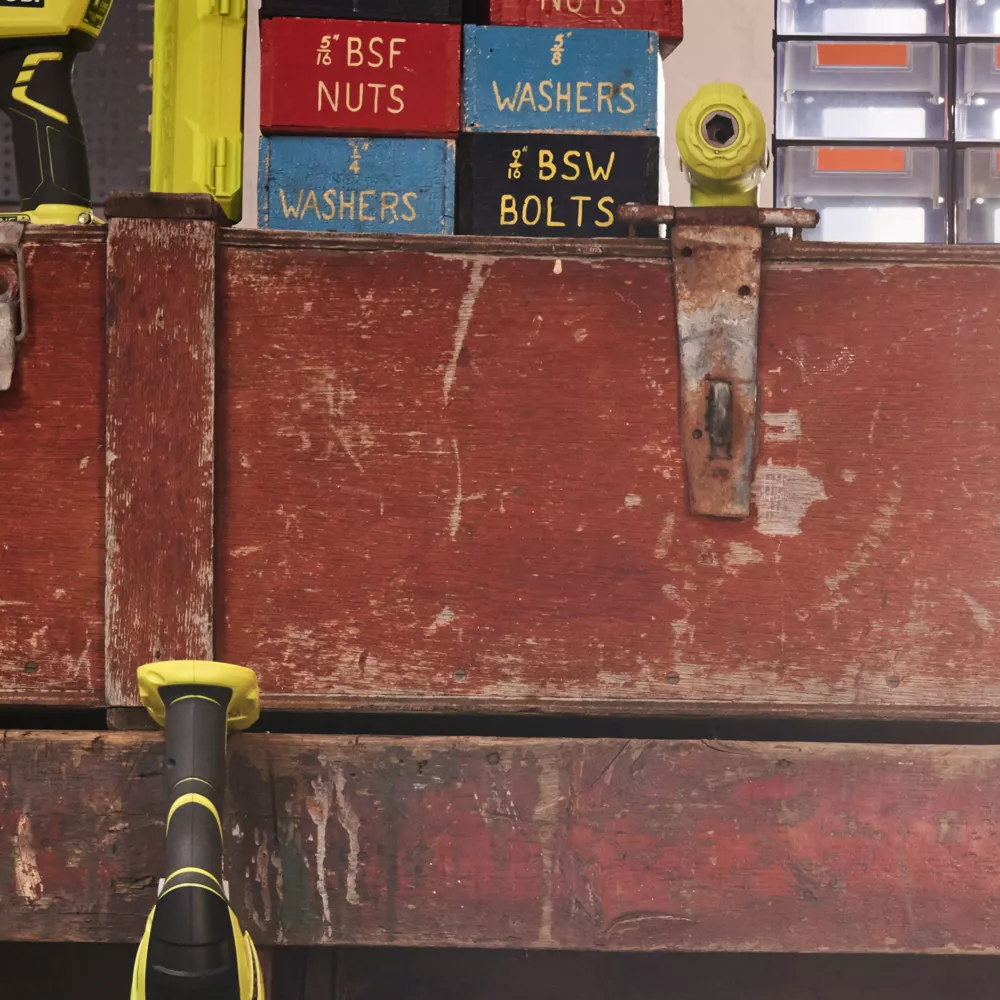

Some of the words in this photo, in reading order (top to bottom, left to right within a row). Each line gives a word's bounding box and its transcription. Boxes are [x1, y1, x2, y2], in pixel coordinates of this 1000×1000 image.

[347, 36, 406, 68] BSF
[317, 80, 405, 114] NUTS
[492, 80, 636, 115] WASHERS
[538, 149, 616, 181] BSW
[279, 188, 418, 223] WASHERS
[500, 194, 615, 227] BOLTS
